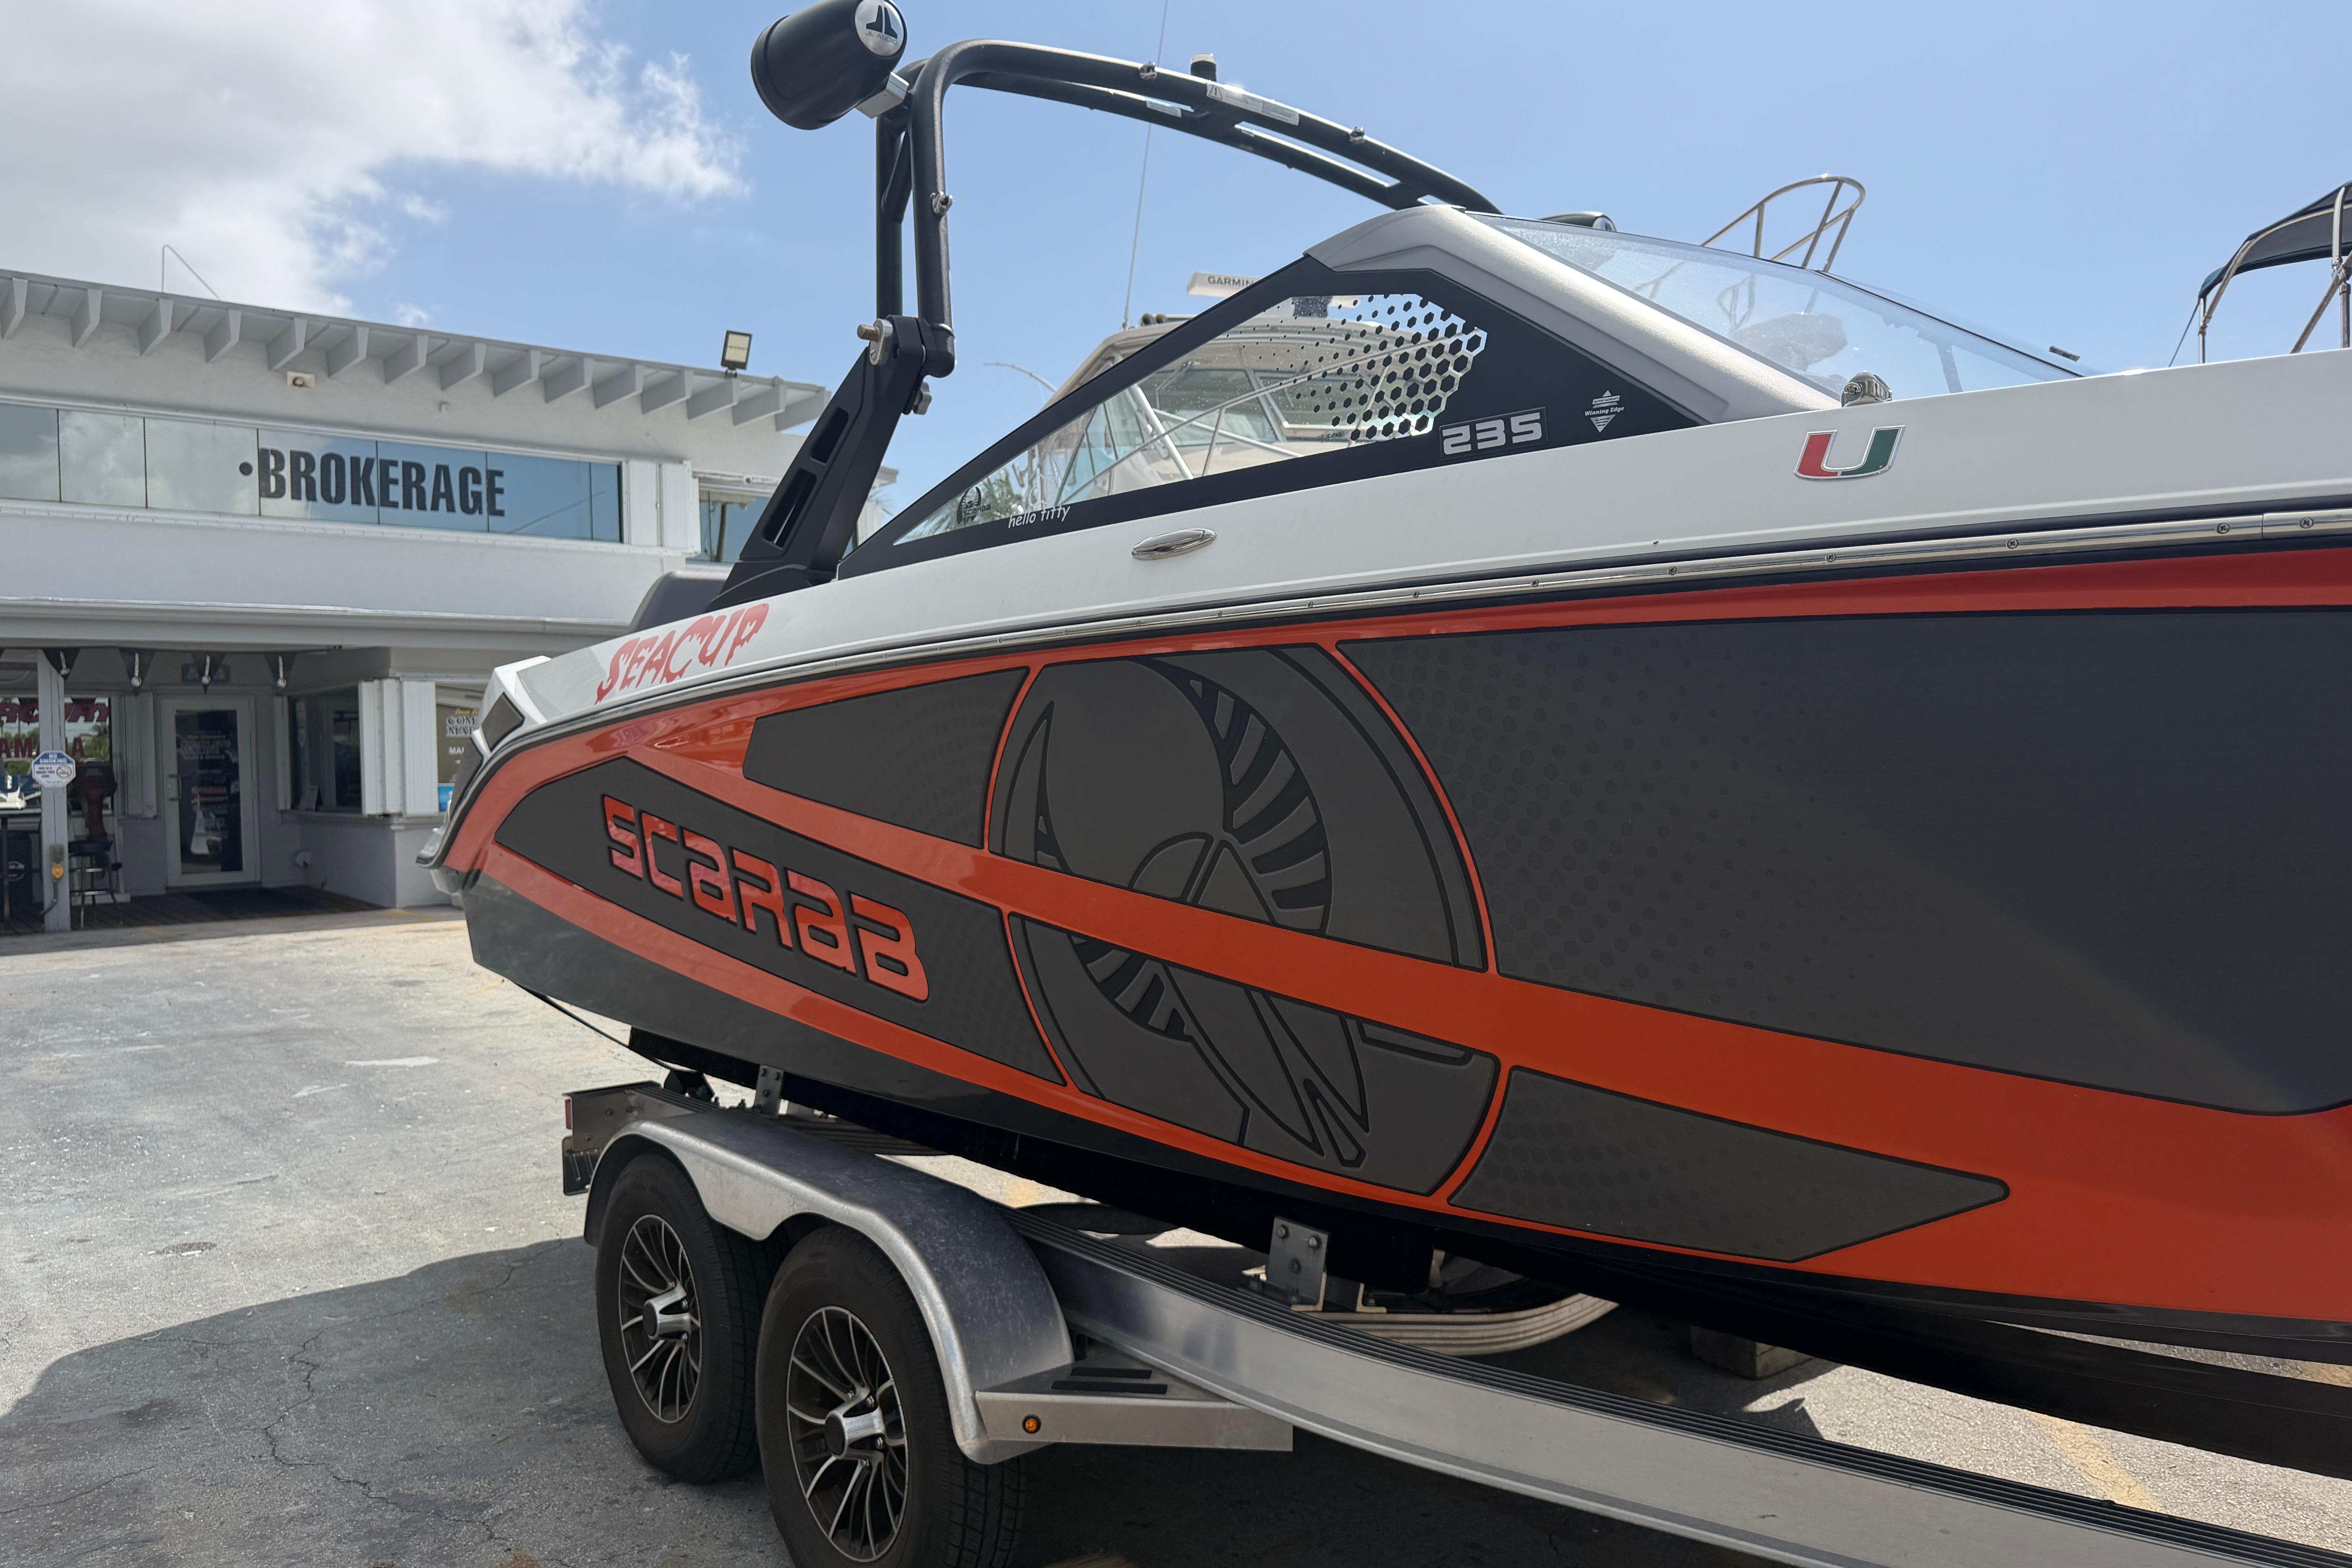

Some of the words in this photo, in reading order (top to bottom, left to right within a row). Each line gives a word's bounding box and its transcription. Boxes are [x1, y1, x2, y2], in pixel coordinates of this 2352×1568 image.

[877, 34, 897, 45] AUDIO
[1208, 276, 1254, 287] GARMIN
[1442, 412, 1542, 455] 235
[259, 448, 505, 516] BROKERAGE
[1008, 511, 1036, 528] hello
